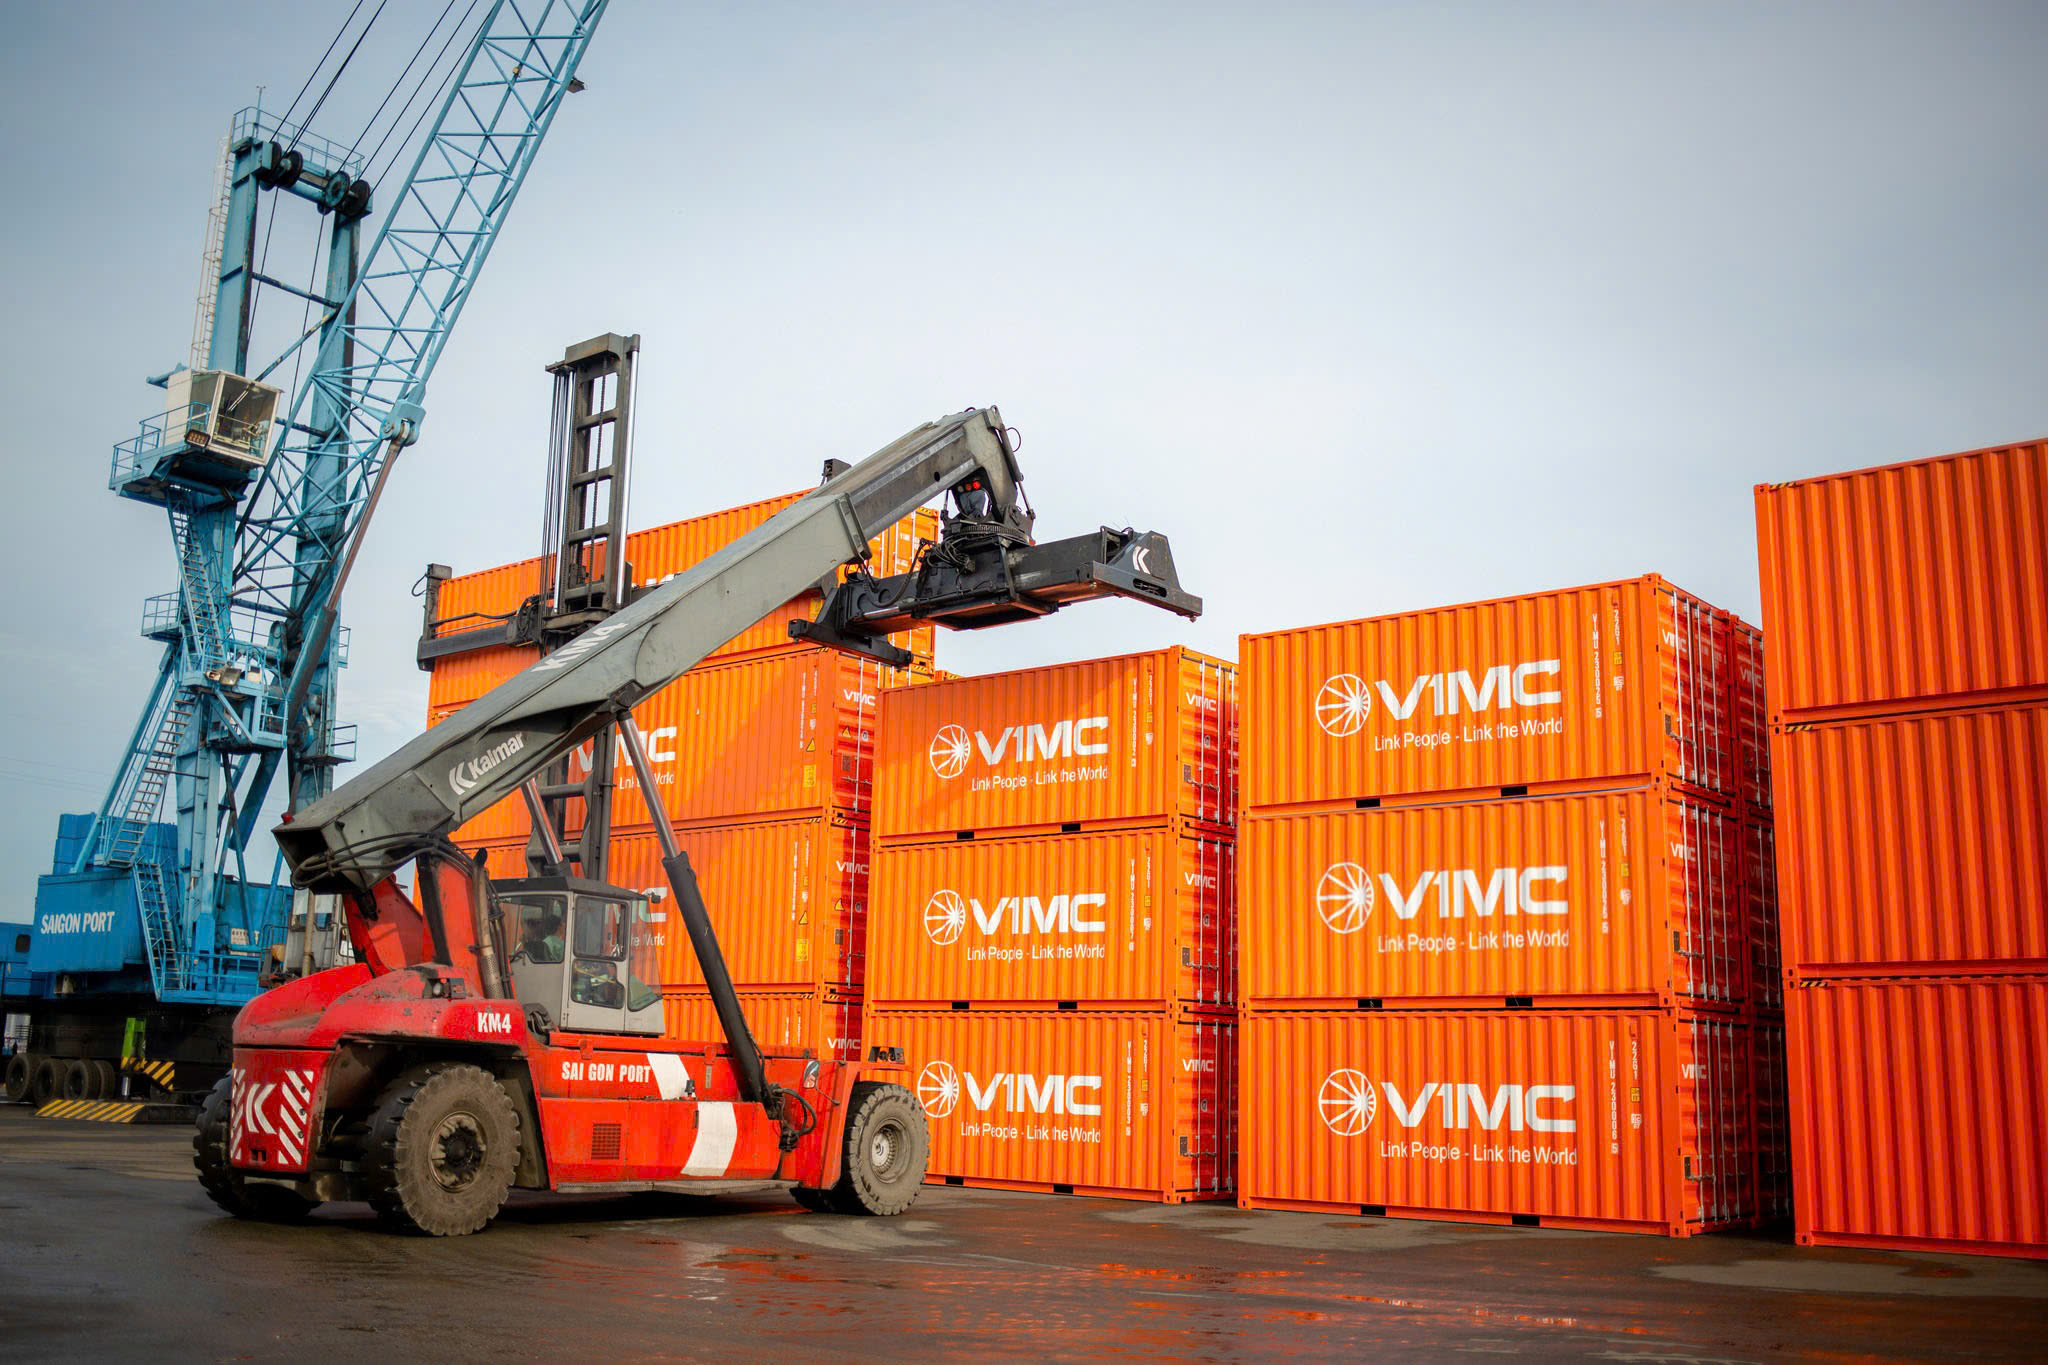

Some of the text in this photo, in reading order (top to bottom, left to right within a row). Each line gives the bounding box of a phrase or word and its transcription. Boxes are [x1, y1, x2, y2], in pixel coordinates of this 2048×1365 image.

[1374, 659, 1562, 721] VIMC
[974, 716, 1109, 766] VIMC
[1374, 734, 1400, 752] Link
[1404, 730, 1450, 750] People
[1463, 724, 1493, 742] Link
[1497, 722, 1519, 739] the
[1520, 717, 1563, 737] World
[467, 732, 524, 780] Kalmar
[971, 777, 991, 792] Link
[993, 775, 1027, 791] People
[1036, 770, 1057, 785] Link
[1060, 769, 1076, 783] the
[1078, 765, 1108, 780] World
[1378, 866, 1568, 920] VIMC
[40, 911, 115, 935] SAIGON PORT
[969, 893, 1106, 935] VIMC
[967, 946, 986, 961] Link
[988, 946, 1023, 964] People
[1032, 945, 1054, 959] Link
[1056, 944, 1072, 958] the
[1074, 943, 1105, 959] World
[1378, 935, 1405, 953] Link
[1407, 932, 1456, 956] People
[1469, 930, 1498, 950] Link
[1503, 931, 1525, 948] the
[1526, 928, 1569, 947] World
[478, 1011, 512, 1034] KM4
[561, 1061, 651, 1083] SAI GON PORT
[963, 1072, 1102, 1116] VIMC
[1380, 1082, 1577, 1133] VIMC
[961, 1122, 980, 1137] Link
[982, 1122, 1018, 1142] People
[1026, 1125, 1049, 1140] Link
[1052, 1126, 1068, 1141] the
[1069, 1127, 1101, 1144] World
[1380, 1141, 1408, 1159] Link
[1411, 1141, 1460, 1163] People
[1473, 1144, 1505, 1162] Link
[1508, 1145, 1531, 1163] the
[1533, 1146, 1578, 1165] World
